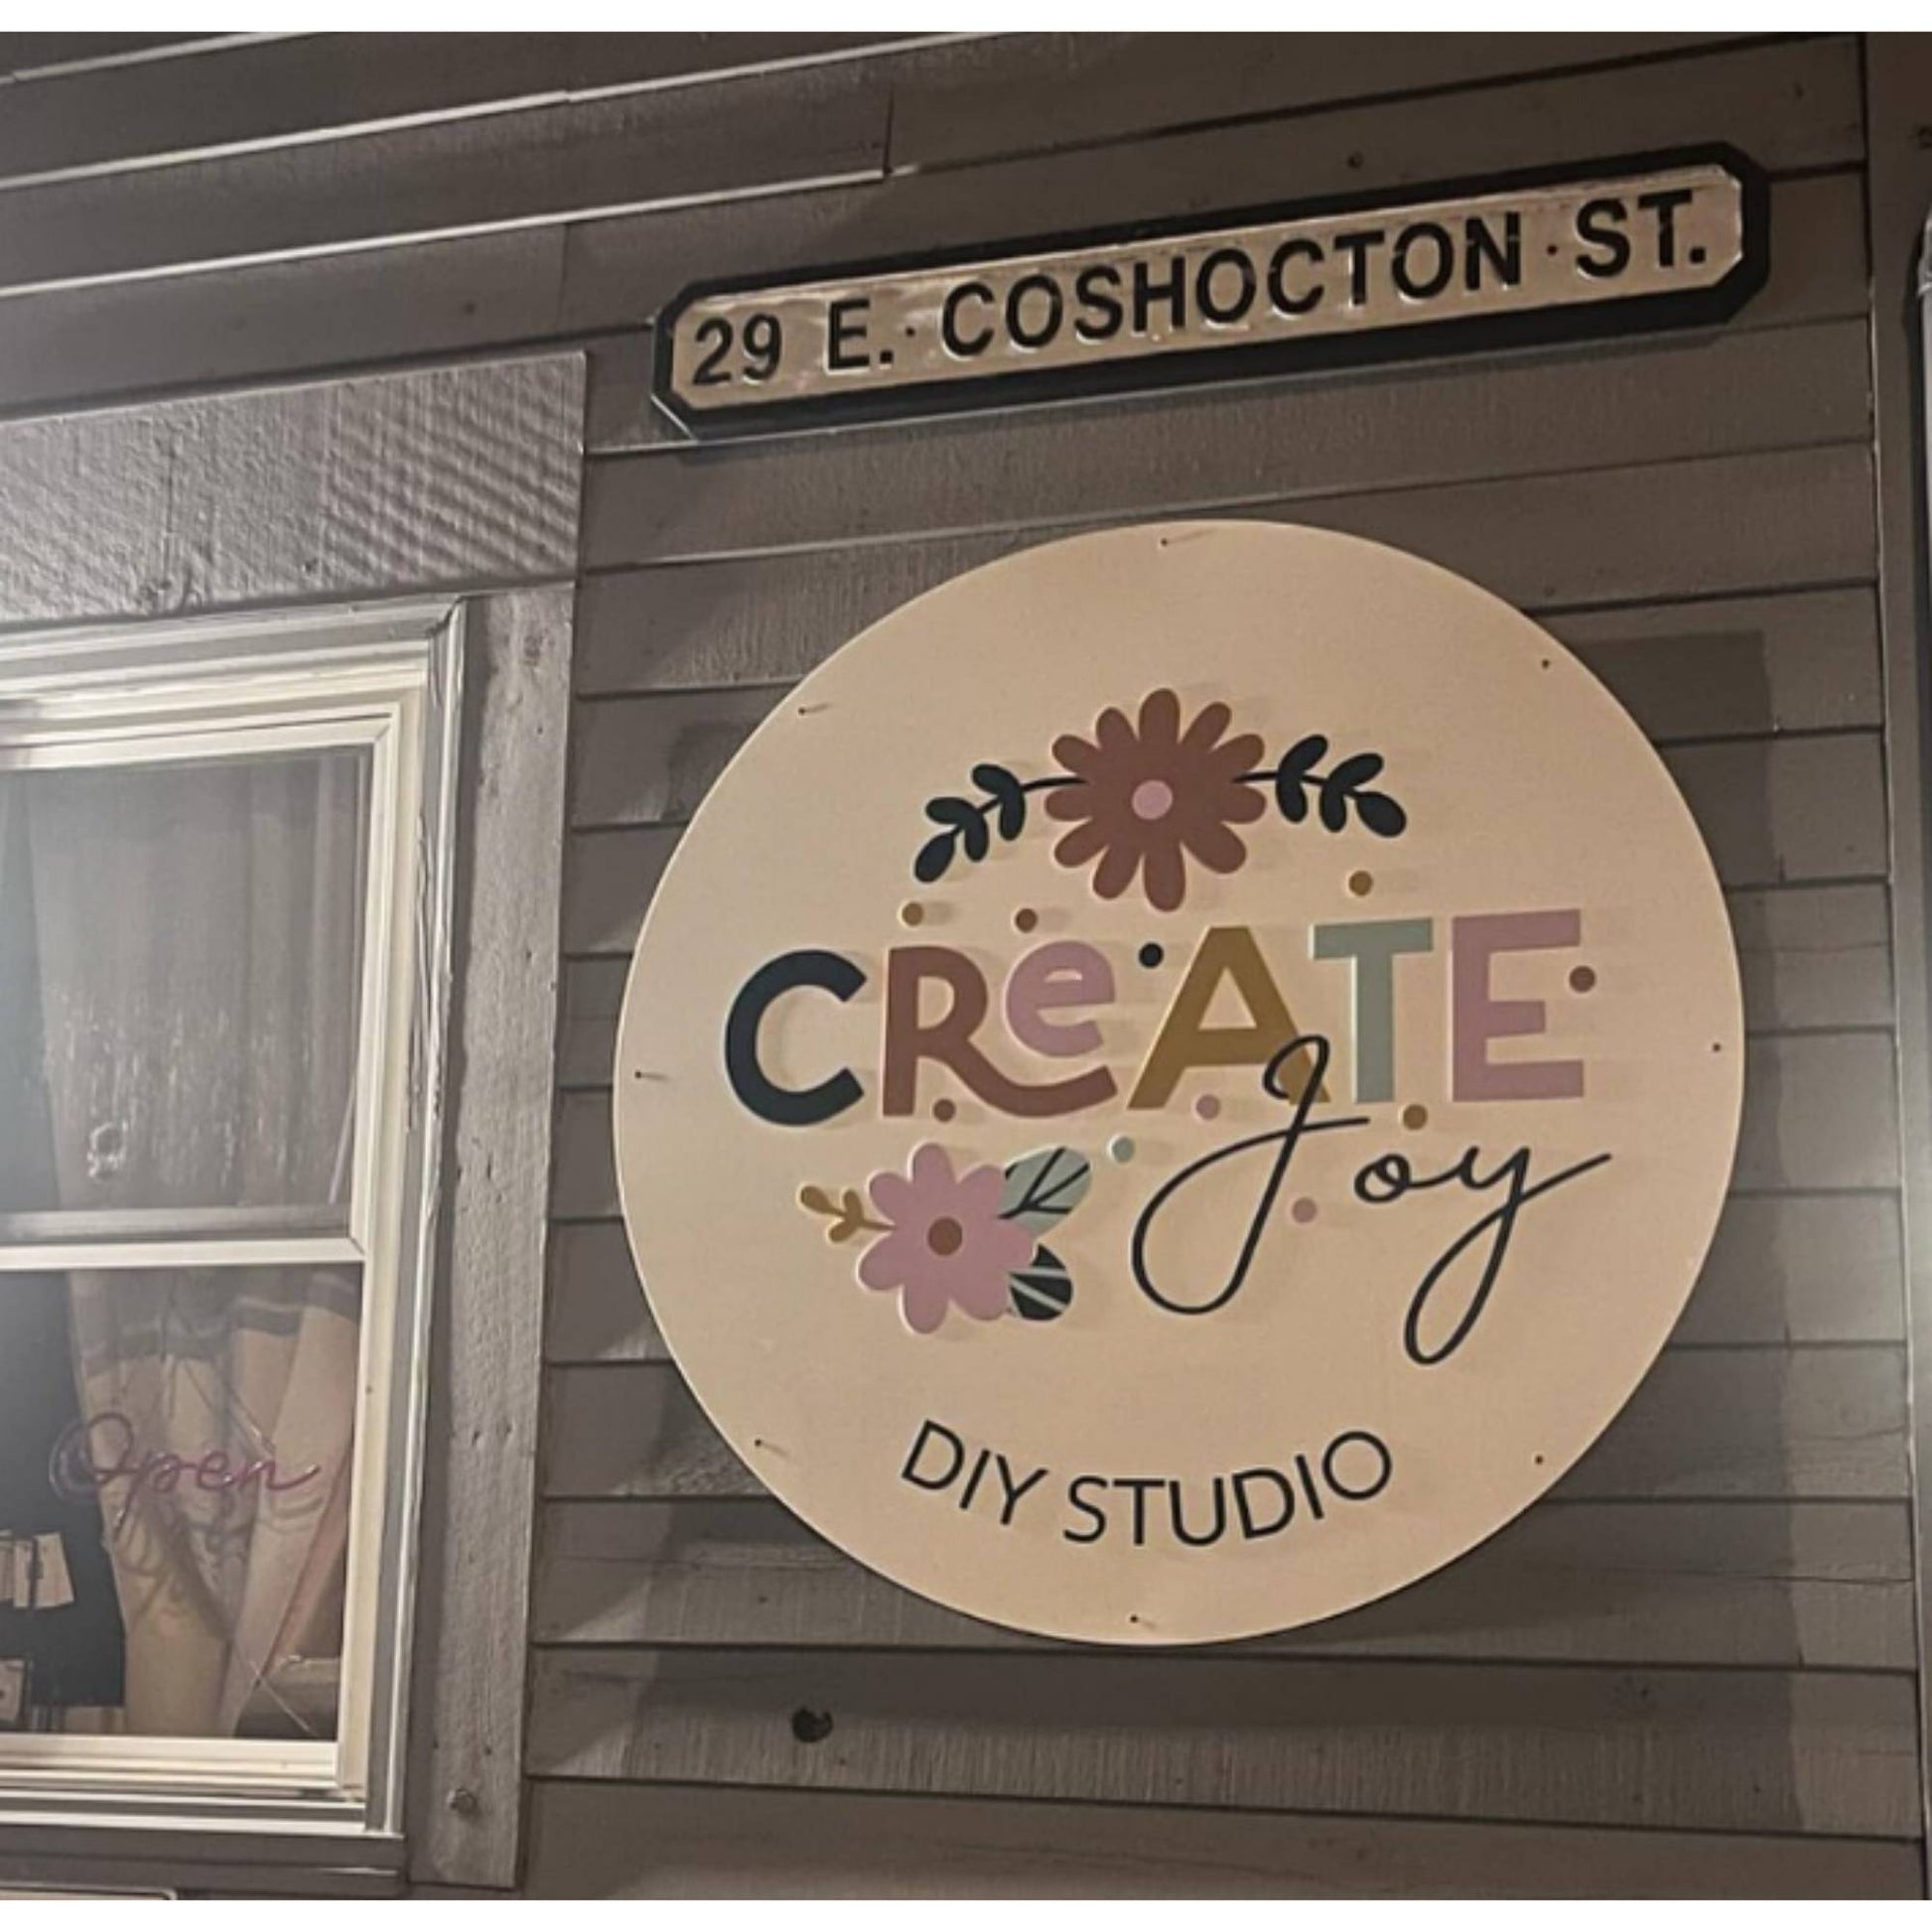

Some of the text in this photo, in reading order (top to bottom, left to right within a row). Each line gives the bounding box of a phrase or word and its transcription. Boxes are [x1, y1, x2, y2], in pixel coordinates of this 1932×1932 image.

[692, 189, 1707, 385] 29 E. COSHOCTON ST.
[1131, 1034, 1612, 1366] Joy
[52, 1411, 321, 1542] Open
[901, 1420, 1393, 1547] DIY STUDIO
